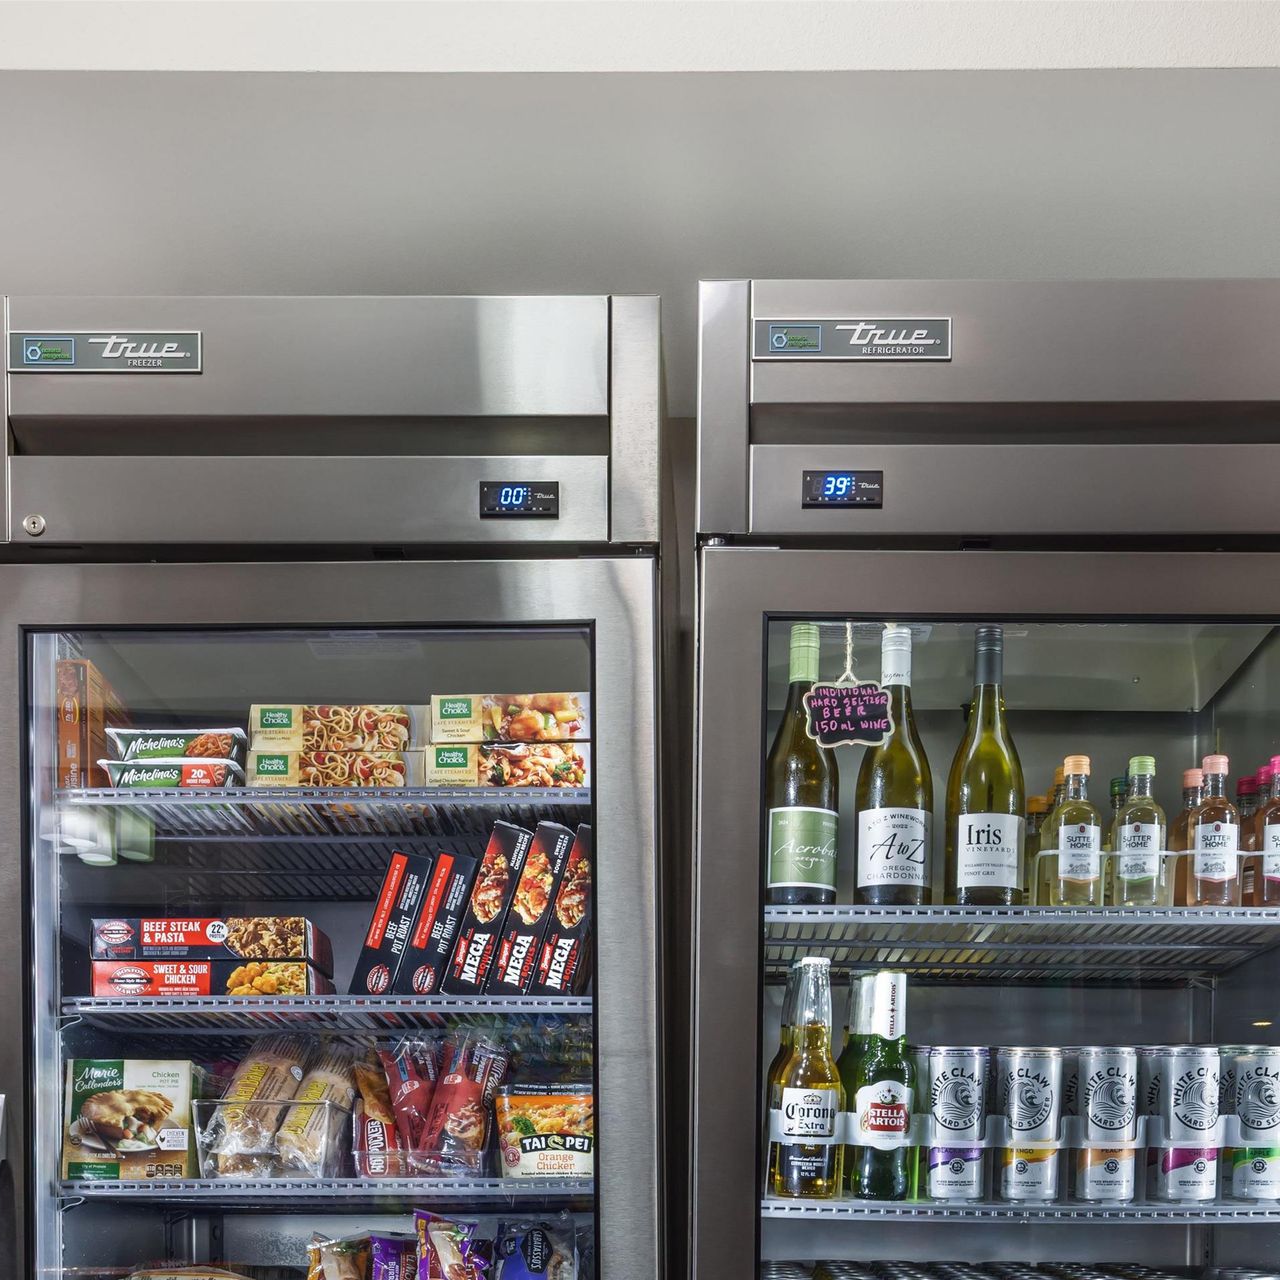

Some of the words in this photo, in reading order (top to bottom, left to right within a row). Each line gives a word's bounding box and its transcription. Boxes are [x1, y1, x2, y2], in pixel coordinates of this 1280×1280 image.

[835, 322, 935, 346] true
[88, 335, 186, 359] true
[862, 346, 925, 354] REFRIGERATOR
[127, 359, 163, 367] FREEZER
[824, 477, 848, 495] 39
[501, 488, 524, 505] 00
[819, 686, 880, 697] INDIVIDUAL
[811, 698, 838, 708] HARD
[843, 696, 889, 707] SELTZER
[262, 716, 290, 725] Choice
[265, 711, 289, 720] Healthy
[823, 706, 867, 719] BEER
[816, 720, 838, 733] 150
[861, 718, 889, 729] WINE
[129, 736, 185, 754] Michelina's
[121, 768, 179, 785] Michelina's
[967, 824, 1003, 846] Iris
[1122, 834, 1153, 843] SUTTER
[553, 859, 561, 874] SOUR
[559, 836, 569, 859] CHICKEN
[870, 833, 896, 861] A
[906, 839, 927, 864] Z
[143, 921, 168, 932] BEEF
[169, 921, 201, 932] STEAK
[384, 921, 398, 939] BEEF
[396, 915, 411, 939] ROAST
[430, 921, 444, 939] BEEF
[442, 914, 457, 939] ROAST
[143, 932, 152, 943] &
[154, 932, 186, 943] PASTA
[391, 939, 404, 954] POT
[437, 939, 450, 954] POT
[460, 933, 491, 984] MEGA
[478, 945, 493, 976] BOWLS
[503, 935, 534, 987] MEGA
[521, 947, 536, 977] BOWLS
[545, 938, 575, 989] MEGA
[564, 950, 578, 981] BOWLS
[153, 965, 178, 974] SWEET
[179, 965, 187, 973] &
[188, 964, 208, 973] SOUR
[164, 975, 196, 984] CHICKEN
[888, 1014, 896, 1037] STELLA
[76, 1067, 121, 1082] Marie
[1173, 1070, 1194, 1107] WHITE
[785, 1102, 836, 1120] Corona
[869, 1108, 905, 1118] STELLA
[798, 1119, 825, 1131] Extra
[869, 1117, 906, 1127] ARTOIS
[522, 1136, 546, 1151] TAI
[565, 1136, 589, 1151] PEI
[538, 1152, 574, 1162] Orange
[536, 1161, 575, 1170] Chicken
